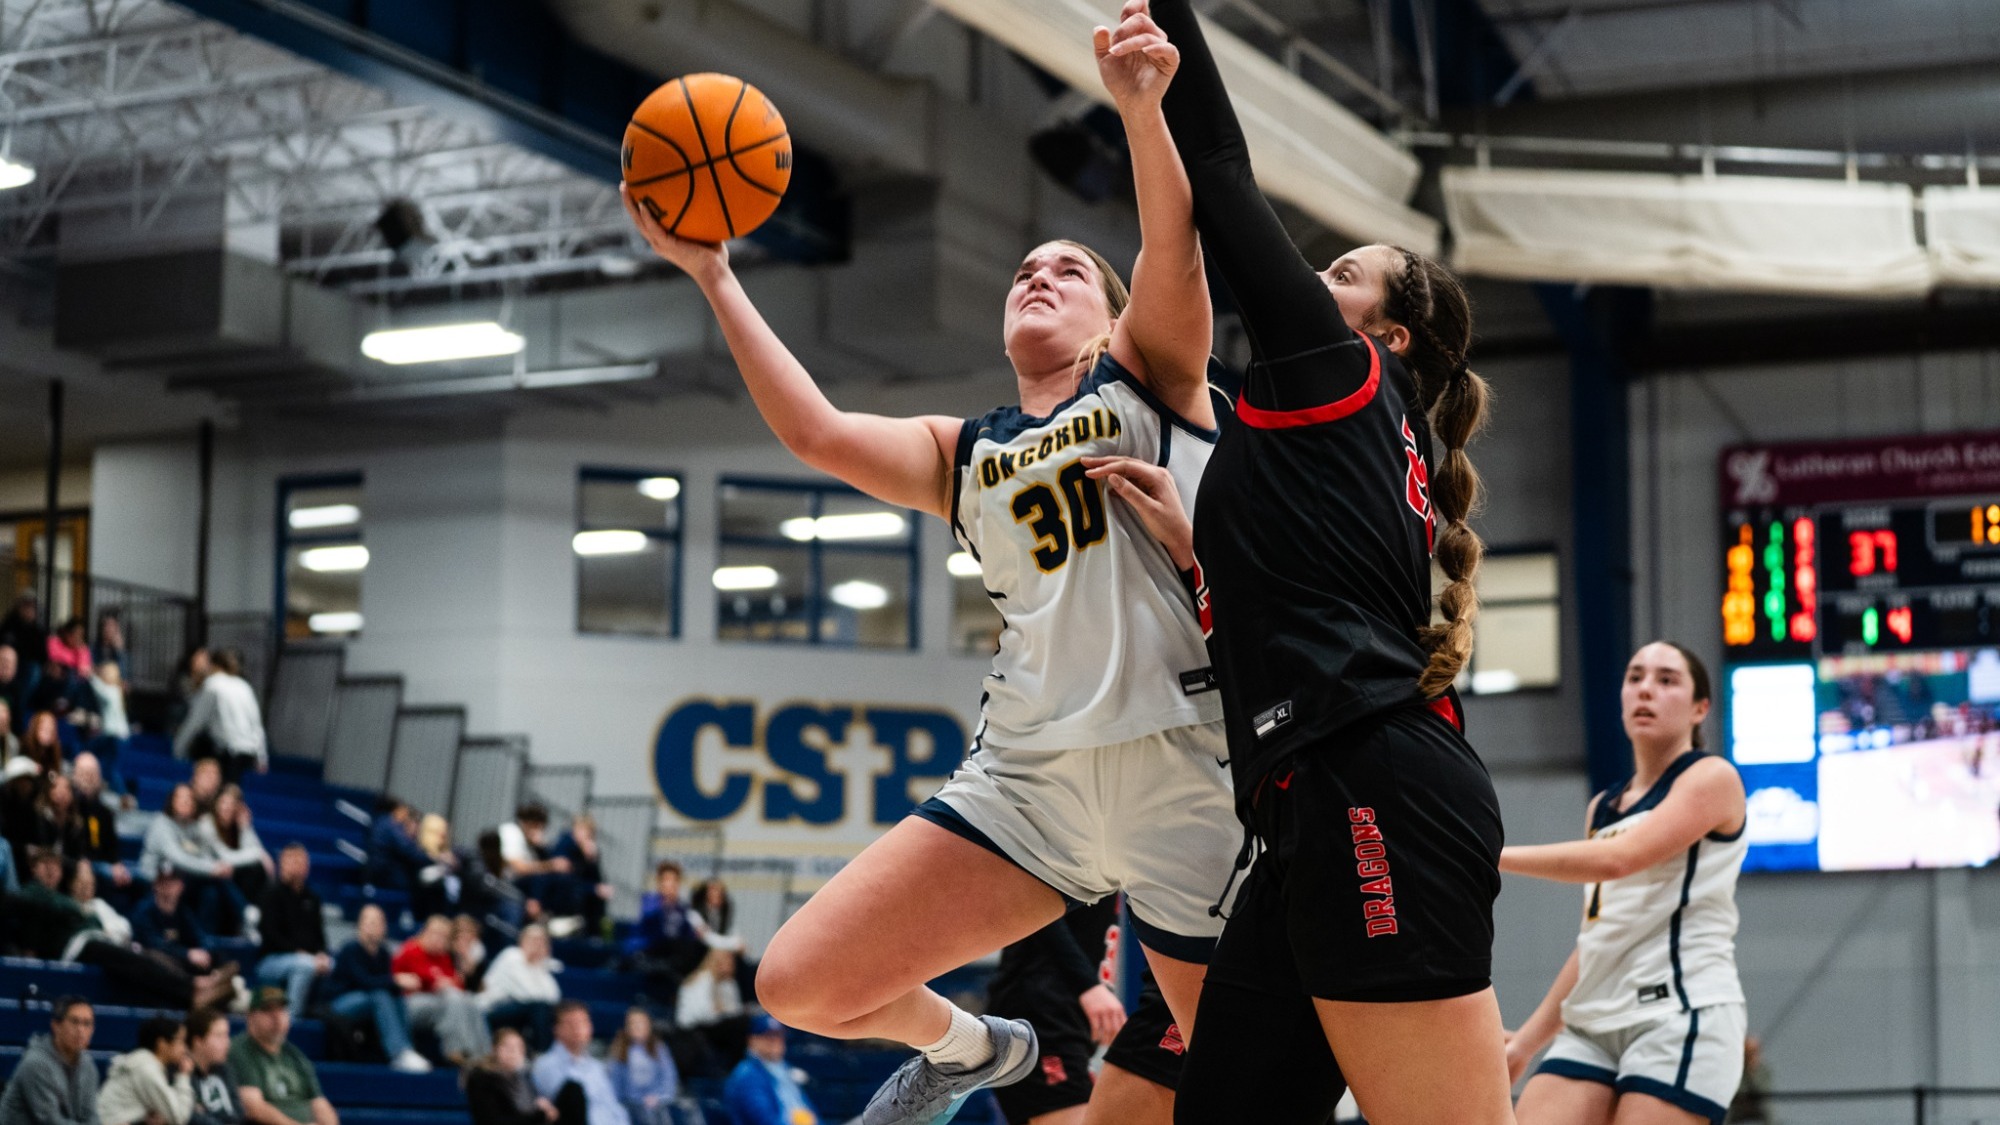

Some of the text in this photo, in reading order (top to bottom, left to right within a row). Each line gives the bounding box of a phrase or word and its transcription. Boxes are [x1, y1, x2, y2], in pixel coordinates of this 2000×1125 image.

[978, 409, 1122, 492] ONCORDIA
[1009, 457, 1108, 575] 30
[1849, 529, 1897, 577] 37
[651, 695, 966, 829] CSP
[1276, 708, 1288, 720] XL
[1347, 806, 1399, 938] DRAGONS
